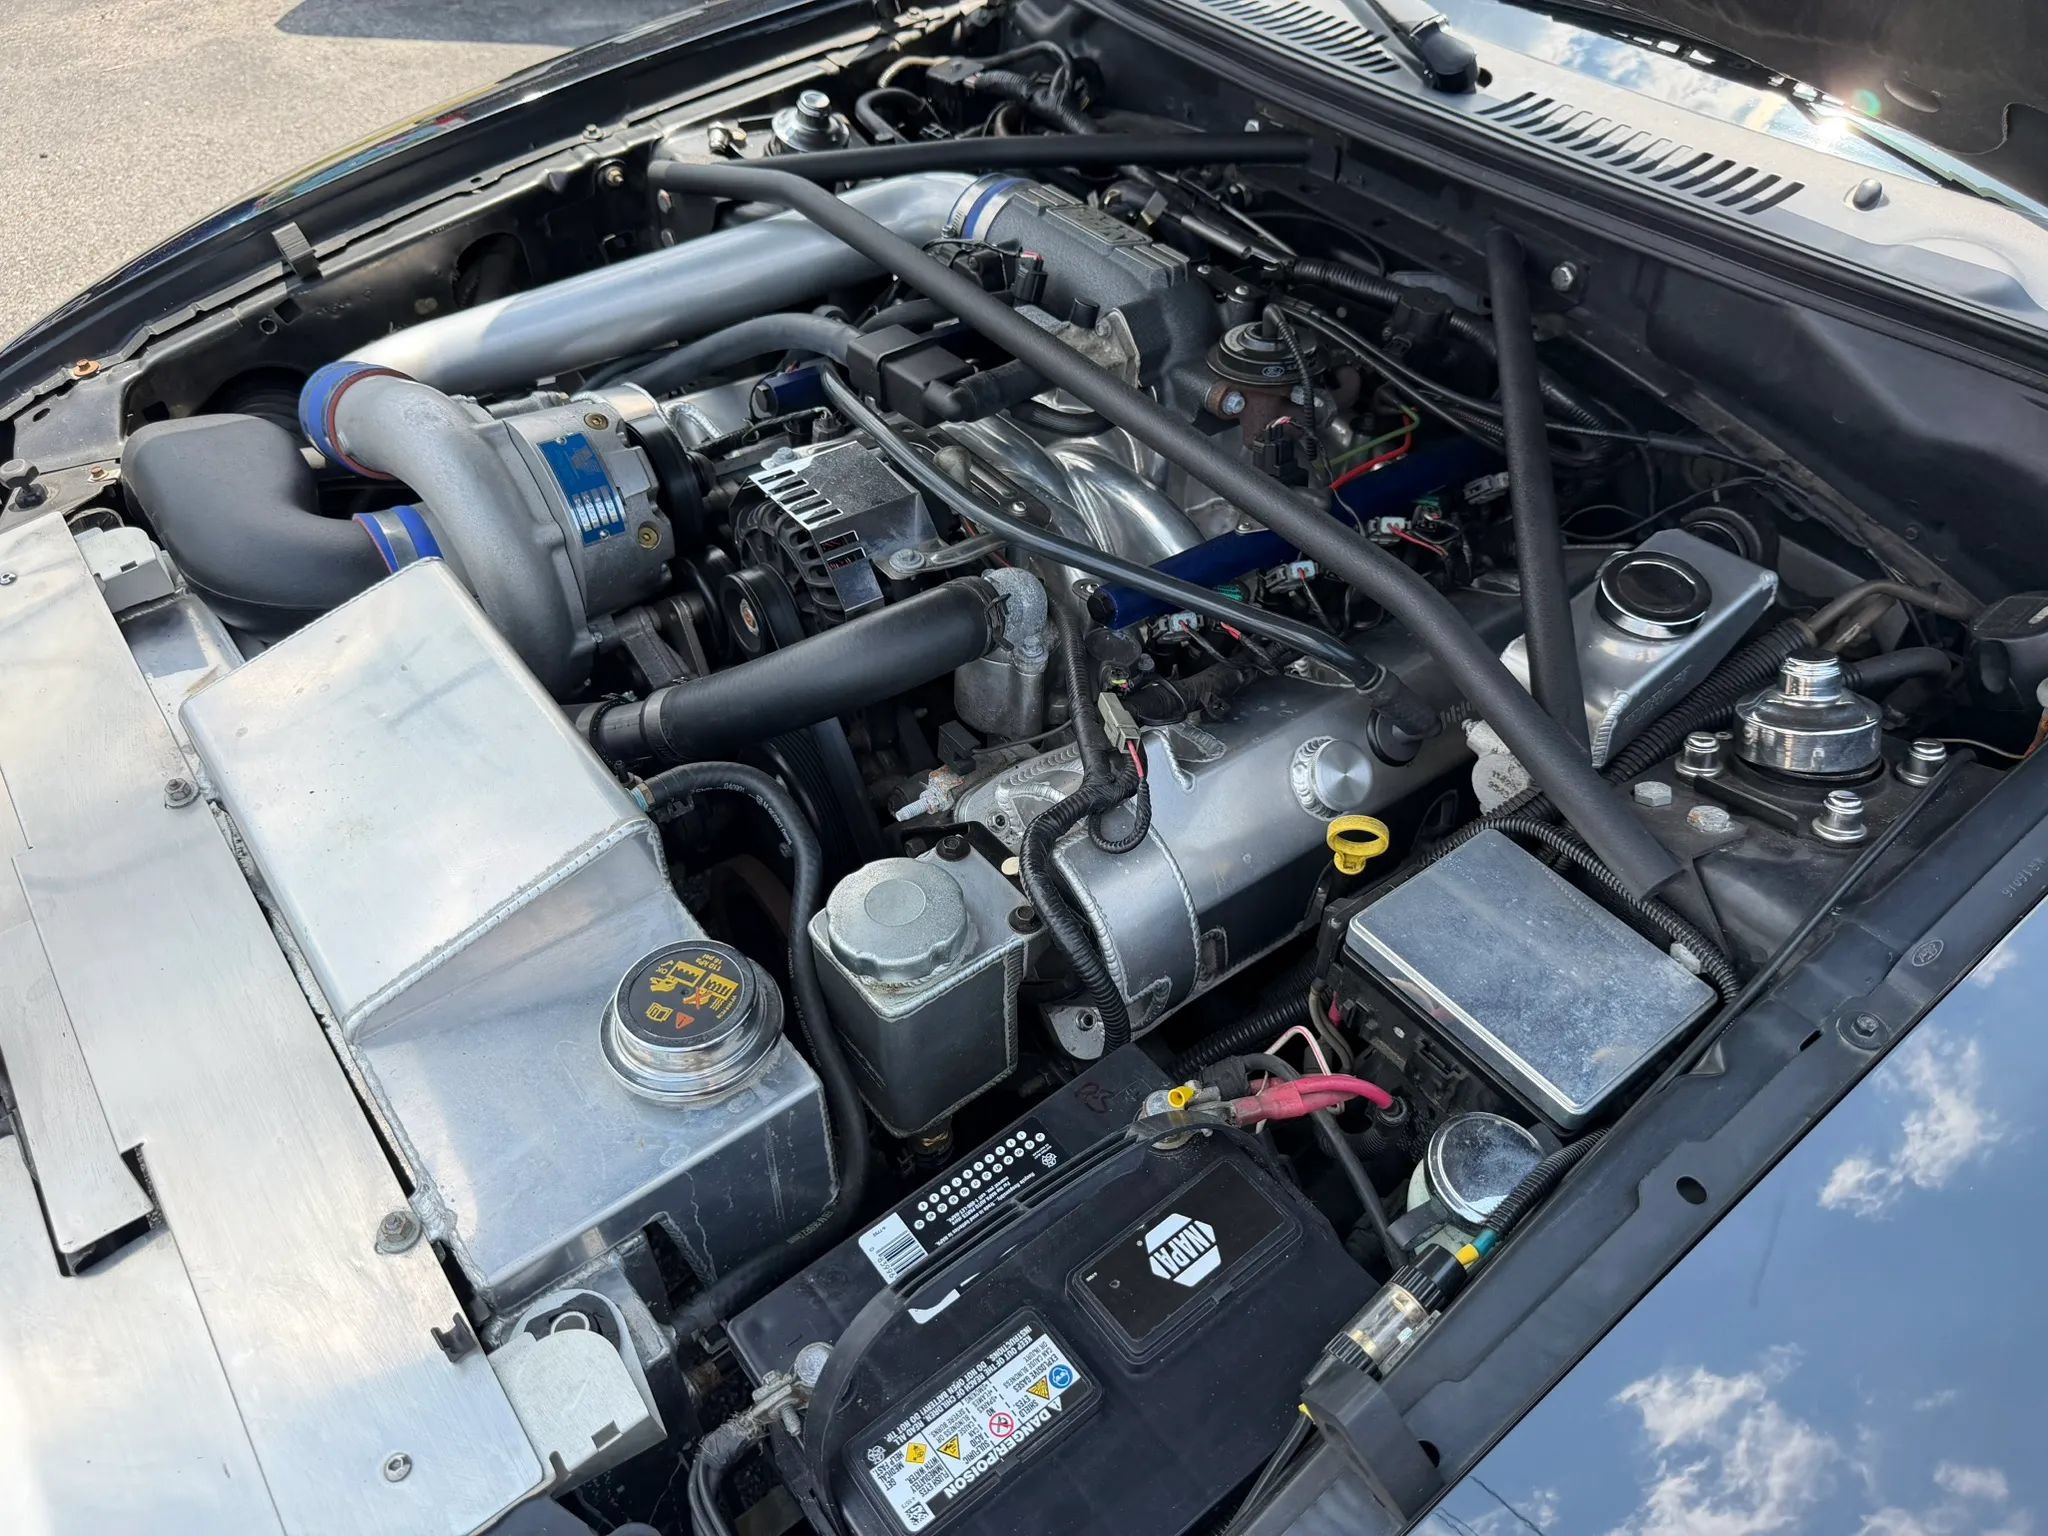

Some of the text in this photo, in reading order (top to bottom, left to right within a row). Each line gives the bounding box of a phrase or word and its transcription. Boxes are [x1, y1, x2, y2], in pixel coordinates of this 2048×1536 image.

[656, 967, 669, 975] OK
[973, 1197, 988, 1209] AUTO
[960, 1206, 976, 1219] PARTS
[1151, 1222, 1211, 1277] NAPA
[1014, 1334, 1033, 1351] KEEP
[993, 1355, 1006, 1368] OF
[1002, 1345, 1018, 1361] OUT
[1025, 1353, 1044, 1370] CAUSE
[982, 1362, 997, 1376] THE
[1001, 1365, 1029, 1389] BLINDNESS
[1011, 1352, 1059, 1393] EXPLOSIVE GASES
[882, 1324, 1033, 1444] INSTRUCTIONS. DO NOT OPEN BATTERY! DO NOT TIP.
[962, 1371, 986, 1392] REACH
[953, 1387, 966, 1399] OF
[1011, 1393, 1031, 1411] EYES.
[945, 1406, 966, 1425] SEVERE
[984, 1405, 996, 1417] NO
[1017, 1398, 1039, 1418] SHIELD
[904, 1418, 925, 1438] READ
[934, 1412, 971, 1444] BLINDNESS OR
[957, 1419, 976, 1436] CAUSE
[967, 1425, 980, 1438] CAN
[892, 1432, 908, 1447] ALL
[968, 1431, 986, 1448] ACID
[941, 1407, 1052, 1499] DANGER/POISON
[961, 1438, 991, 1465] SULFURIC
[871, 1449, 904, 1478] HELP FAST.
[877, 1459, 905, 1484] MEDICAL
[904, 1454, 939, 1486] WITH WATER.
[882, 1476, 897, 1491] GET
[908, 1462, 945, 1494] IMMEDIATELY
[917, 1469, 950, 1497] FLUSH EYES
